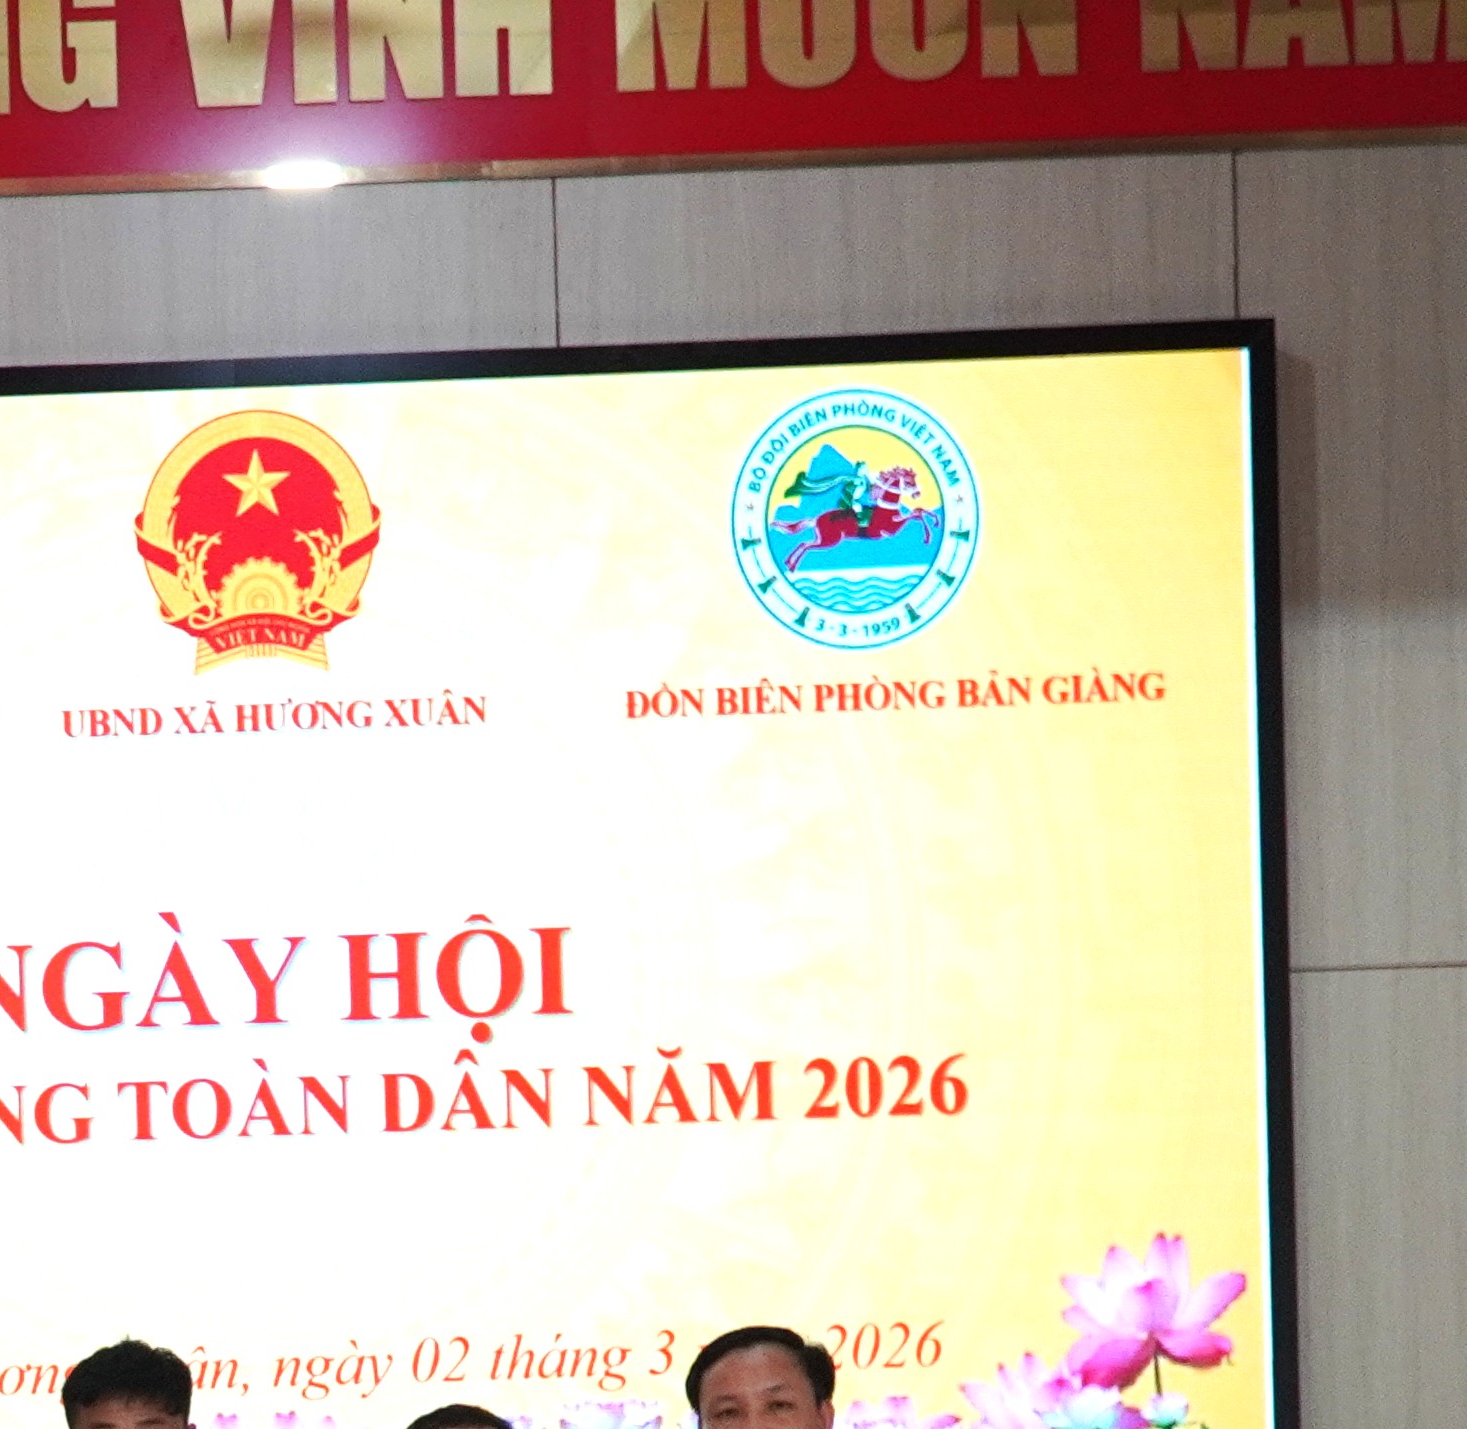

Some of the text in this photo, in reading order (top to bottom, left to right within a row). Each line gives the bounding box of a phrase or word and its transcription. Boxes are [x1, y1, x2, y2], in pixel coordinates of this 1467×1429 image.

[62, 688, 486, 738] UBND XÃ HƯƠNG XUÂN
[715, 677, 802, 716] BIÊN
[813, 675, 946, 713] PHÒNG
[956, 669, 1032, 708] BẢN
[1041, 666, 1167, 705] GIÀNG
[340, 913, 572, 1044] HỘI
[116, 1057, 348, 1141] TOÀN
[382, 1048, 553, 1133] DÂN
[582, 1046, 776, 1126] NĂM
[804, 1053, 969, 1119] 2026
[273, 1339, 394, 1399] ngày
[412, 1336, 470, 1382] 02
[490, 1333, 631, 1390] tháng
[648, 1329, 675, 1376] 3
[829, 1321, 942, 1372] 2026
